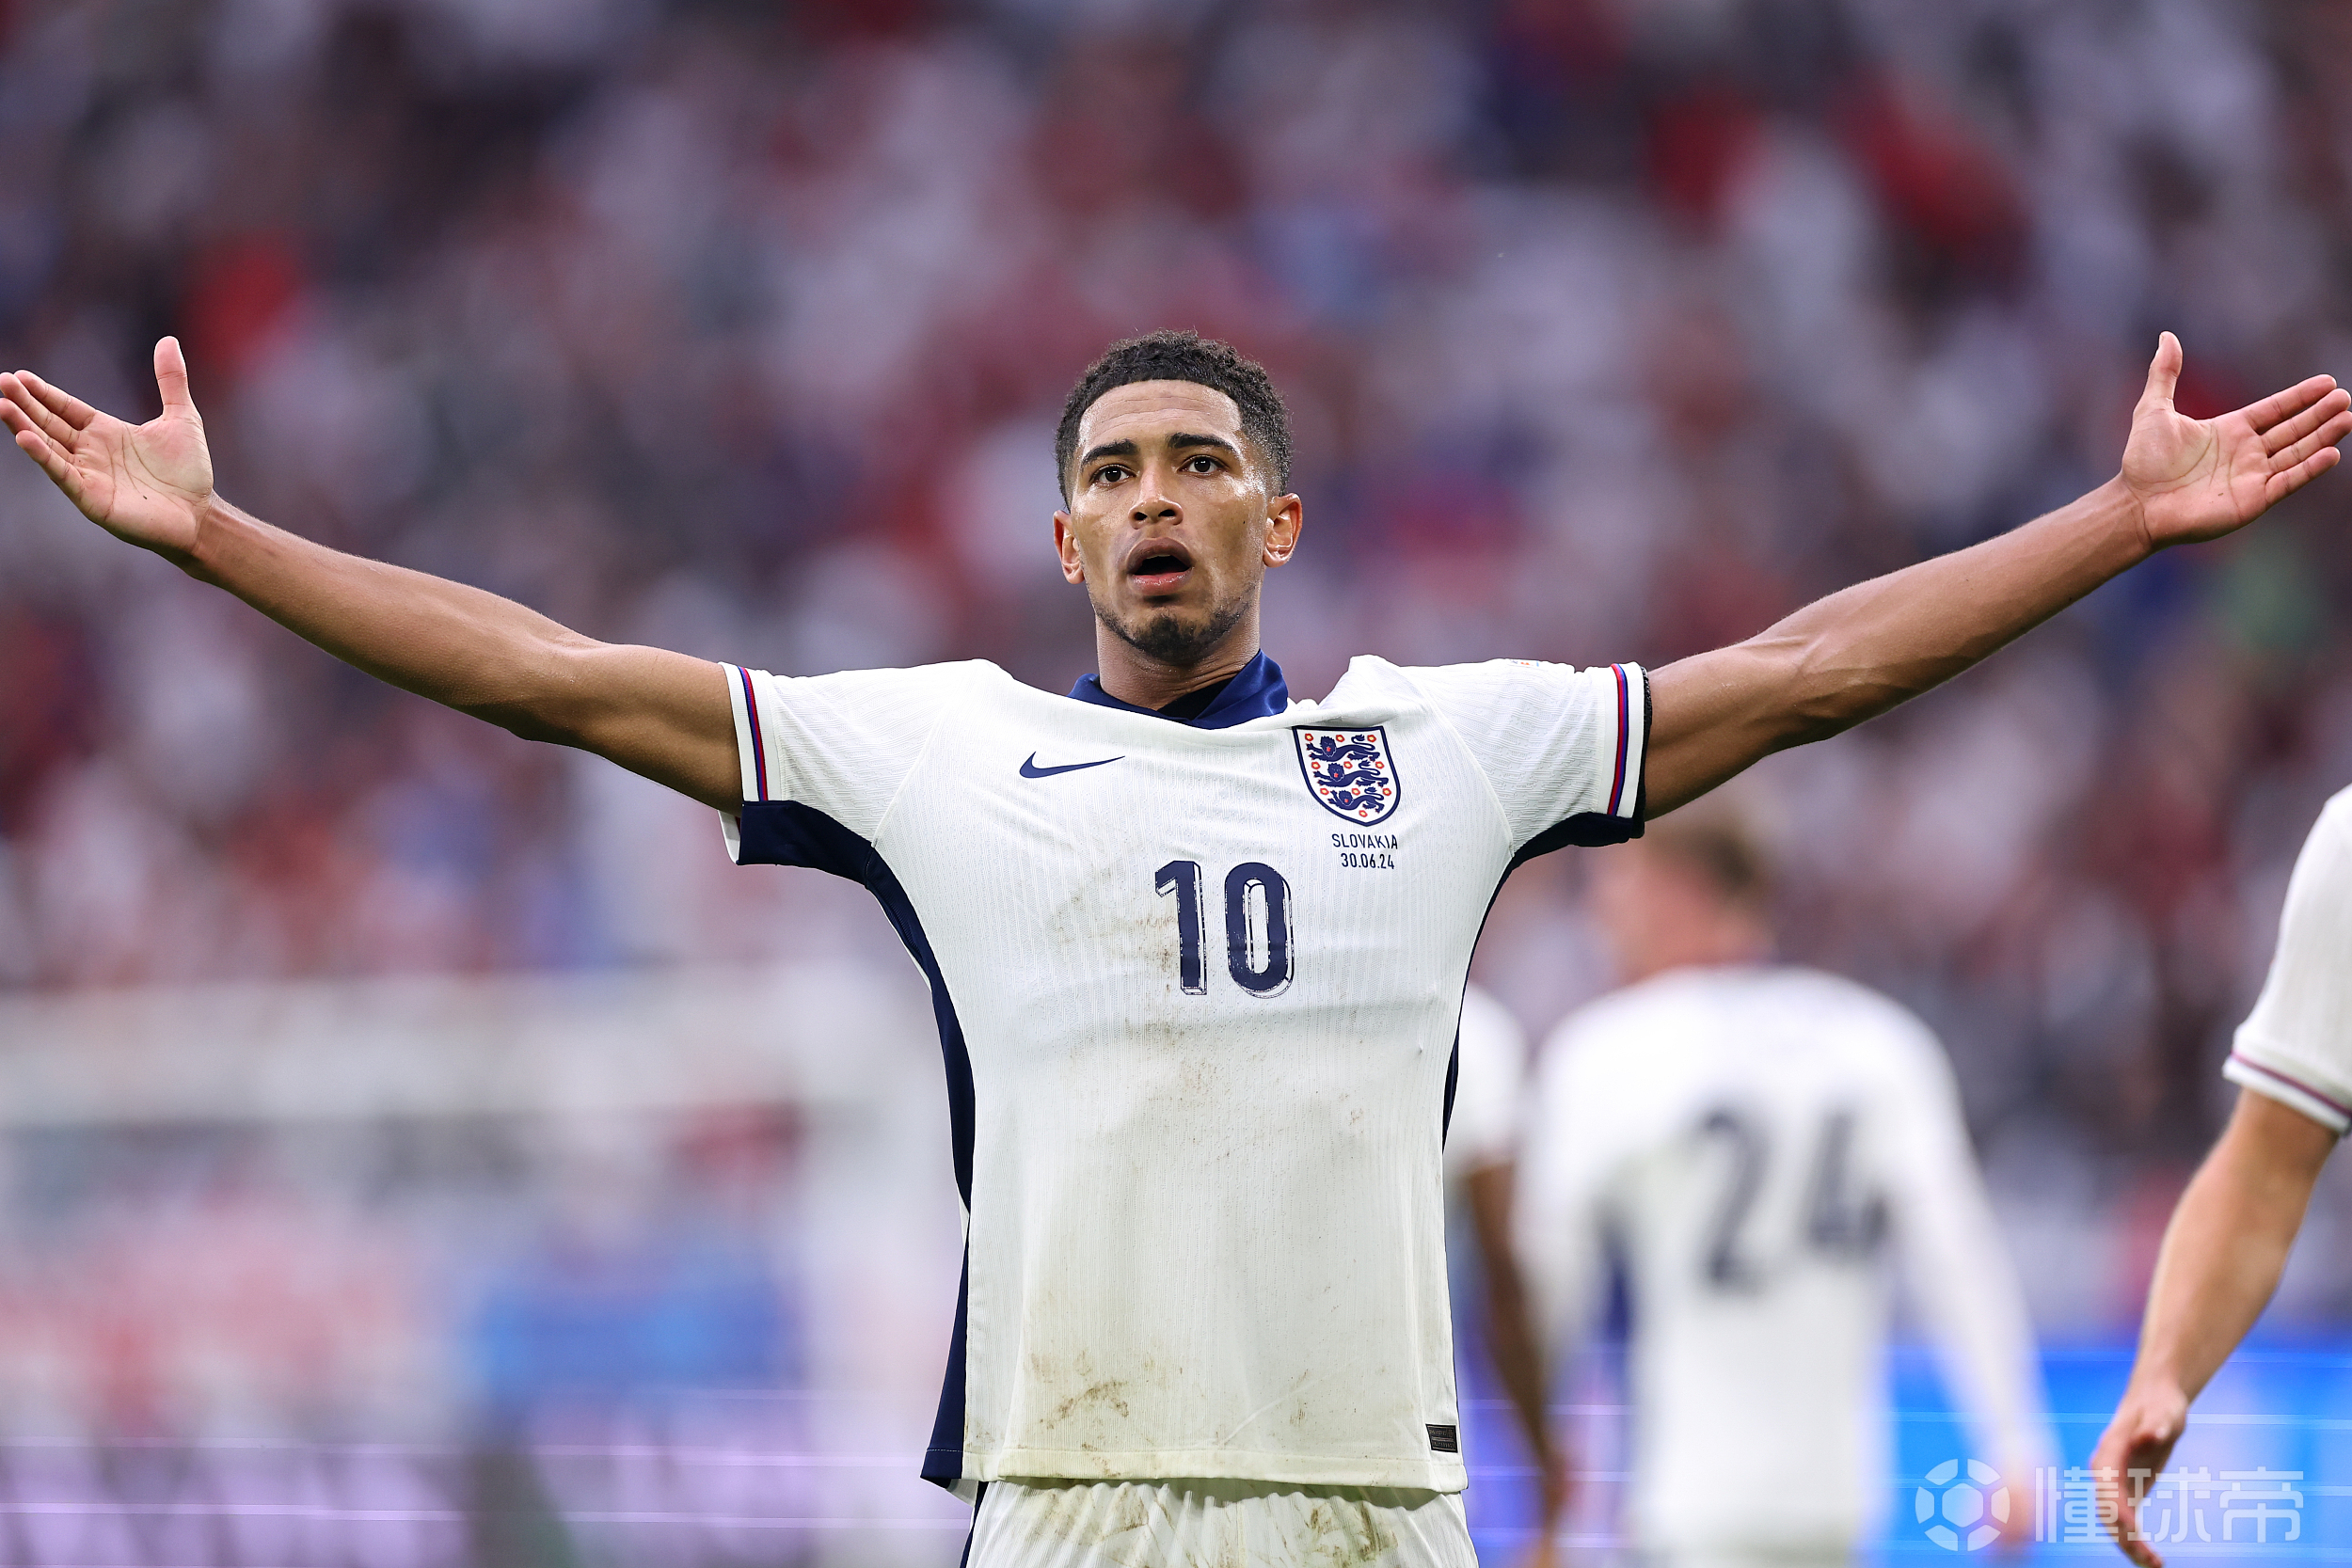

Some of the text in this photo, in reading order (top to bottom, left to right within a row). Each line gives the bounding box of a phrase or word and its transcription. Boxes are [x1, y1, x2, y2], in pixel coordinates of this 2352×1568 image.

[1331, 833, 1398, 849] SLOVAKIA
[1341, 852, 1395, 870] 30.06.24
[1154, 860, 1295, 1000] 10
[1692, 1101, 1891, 1292] 24
